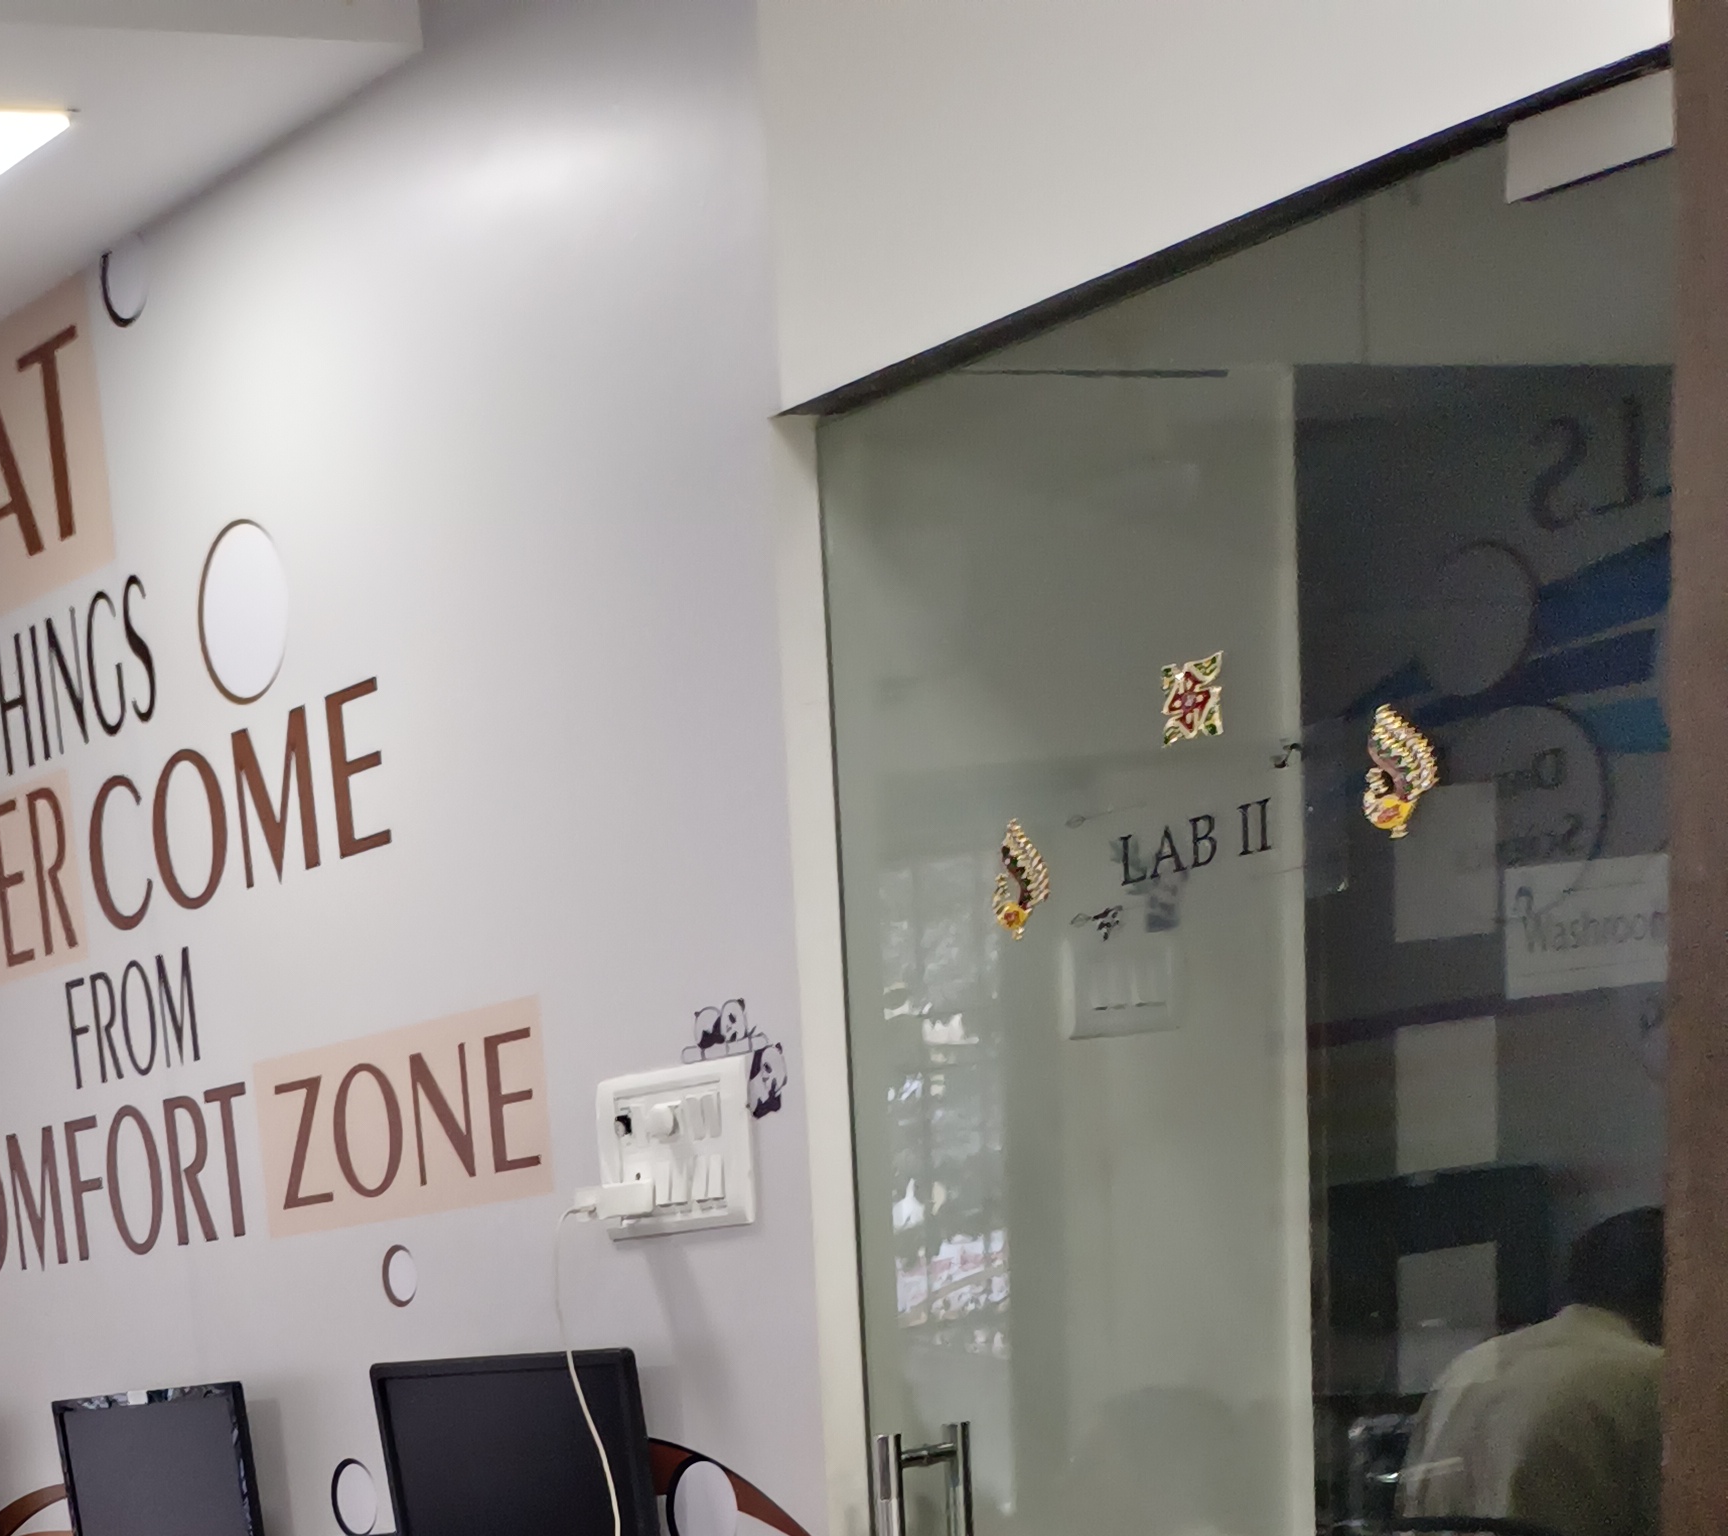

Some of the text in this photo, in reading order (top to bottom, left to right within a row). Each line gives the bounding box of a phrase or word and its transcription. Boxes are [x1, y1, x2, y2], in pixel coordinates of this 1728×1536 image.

[89, 677, 393, 930] COME
[1120, 813, 1218, 887] LAB
[65, 947, 200, 1089] FROM
[273, 1027, 543, 1211] ZONE
